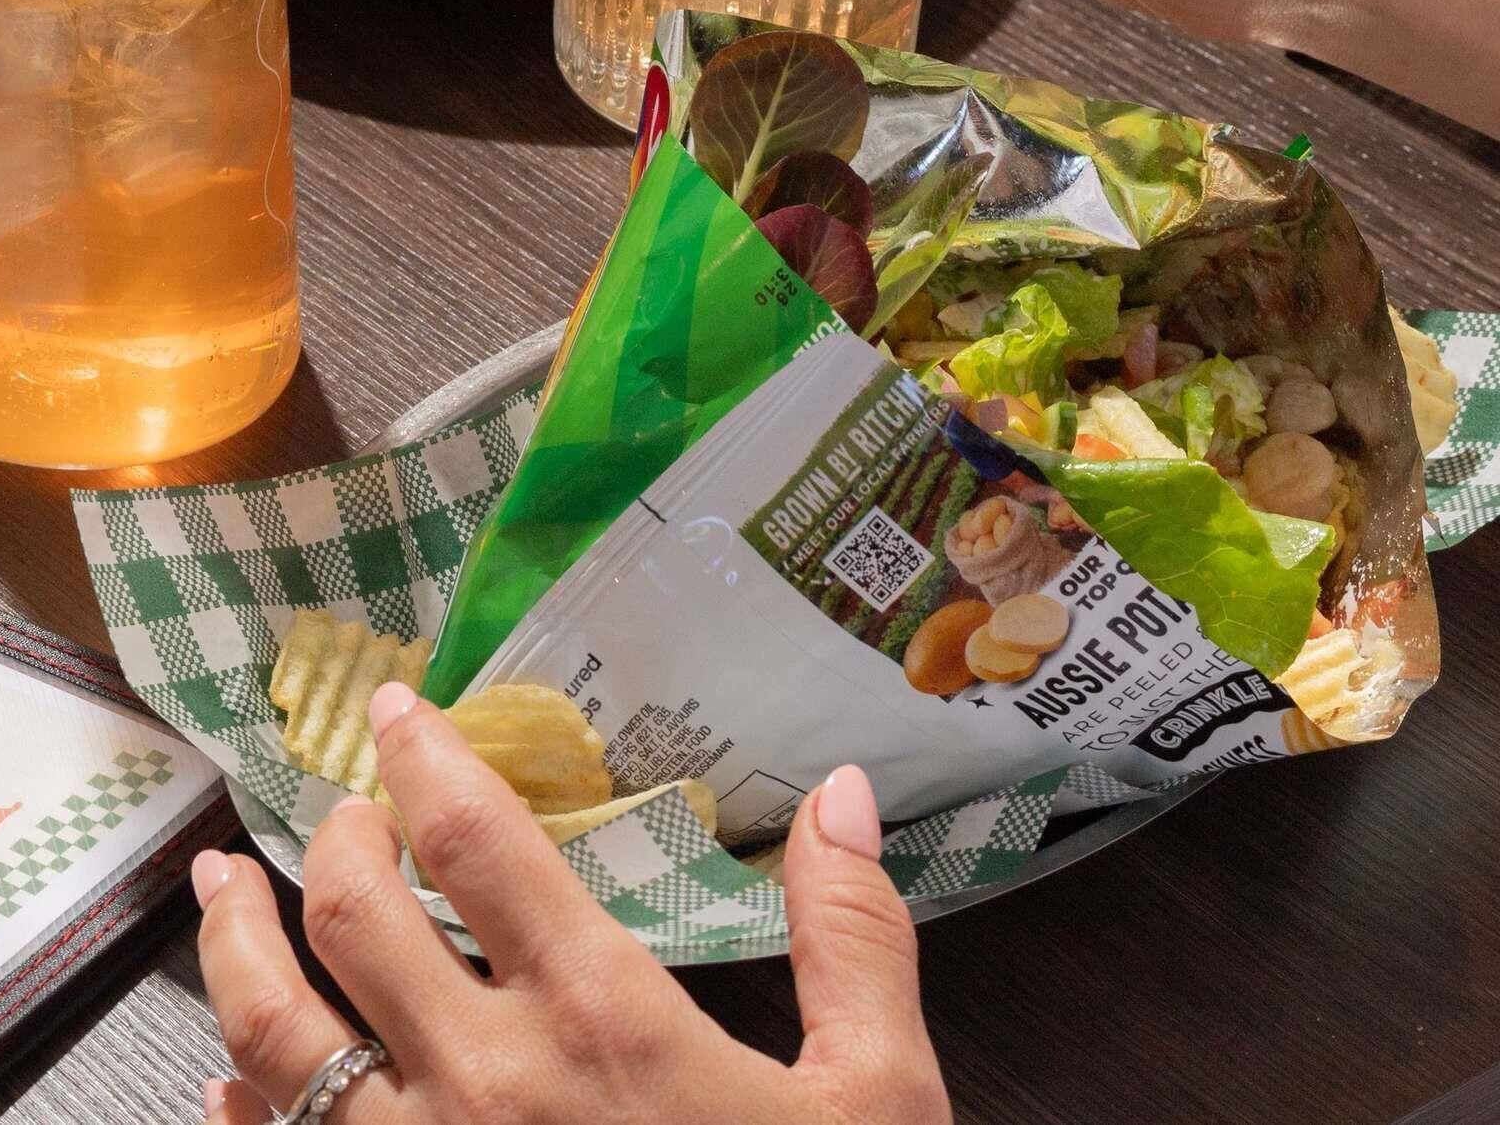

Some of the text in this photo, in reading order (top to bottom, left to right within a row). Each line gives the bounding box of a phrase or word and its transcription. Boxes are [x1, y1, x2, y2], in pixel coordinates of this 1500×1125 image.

[760, 466, 841, 550] GROWN
[823, 442, 860, 477] BY
[792, 397, 950, 565] MEET OUR LOCAL FARMERS
[1059, 555, 1105, 597] OUR
[1076, 573, 1117, 611] TOP
[581, 696, 602, 725] ps
[639, 699, 659, 717] OIL,
[1012, 637, 1132, 730] AUSSIE
[1062, 710, 1109, 743] ARE
[1109, 641, 1194, 711] PEELED
[1080, 730, 1130, 752] TO
[1180, 649, 1241, 688] THE
[1150, 675, 1272, 750] CRINKLE
[606, 742, 636, 775] NCERS
[616, 759, 641, 783] RIDE),
[657, 698, 699, 741] FLAVOURS
[634, 747, 671, 784] SOLUBLE
[668, 724, 693, 749] FIBRE
[652, 725, 711, 785] PROTEIN, FOOD
[690, 738, 733, 780] ROSEMARY
